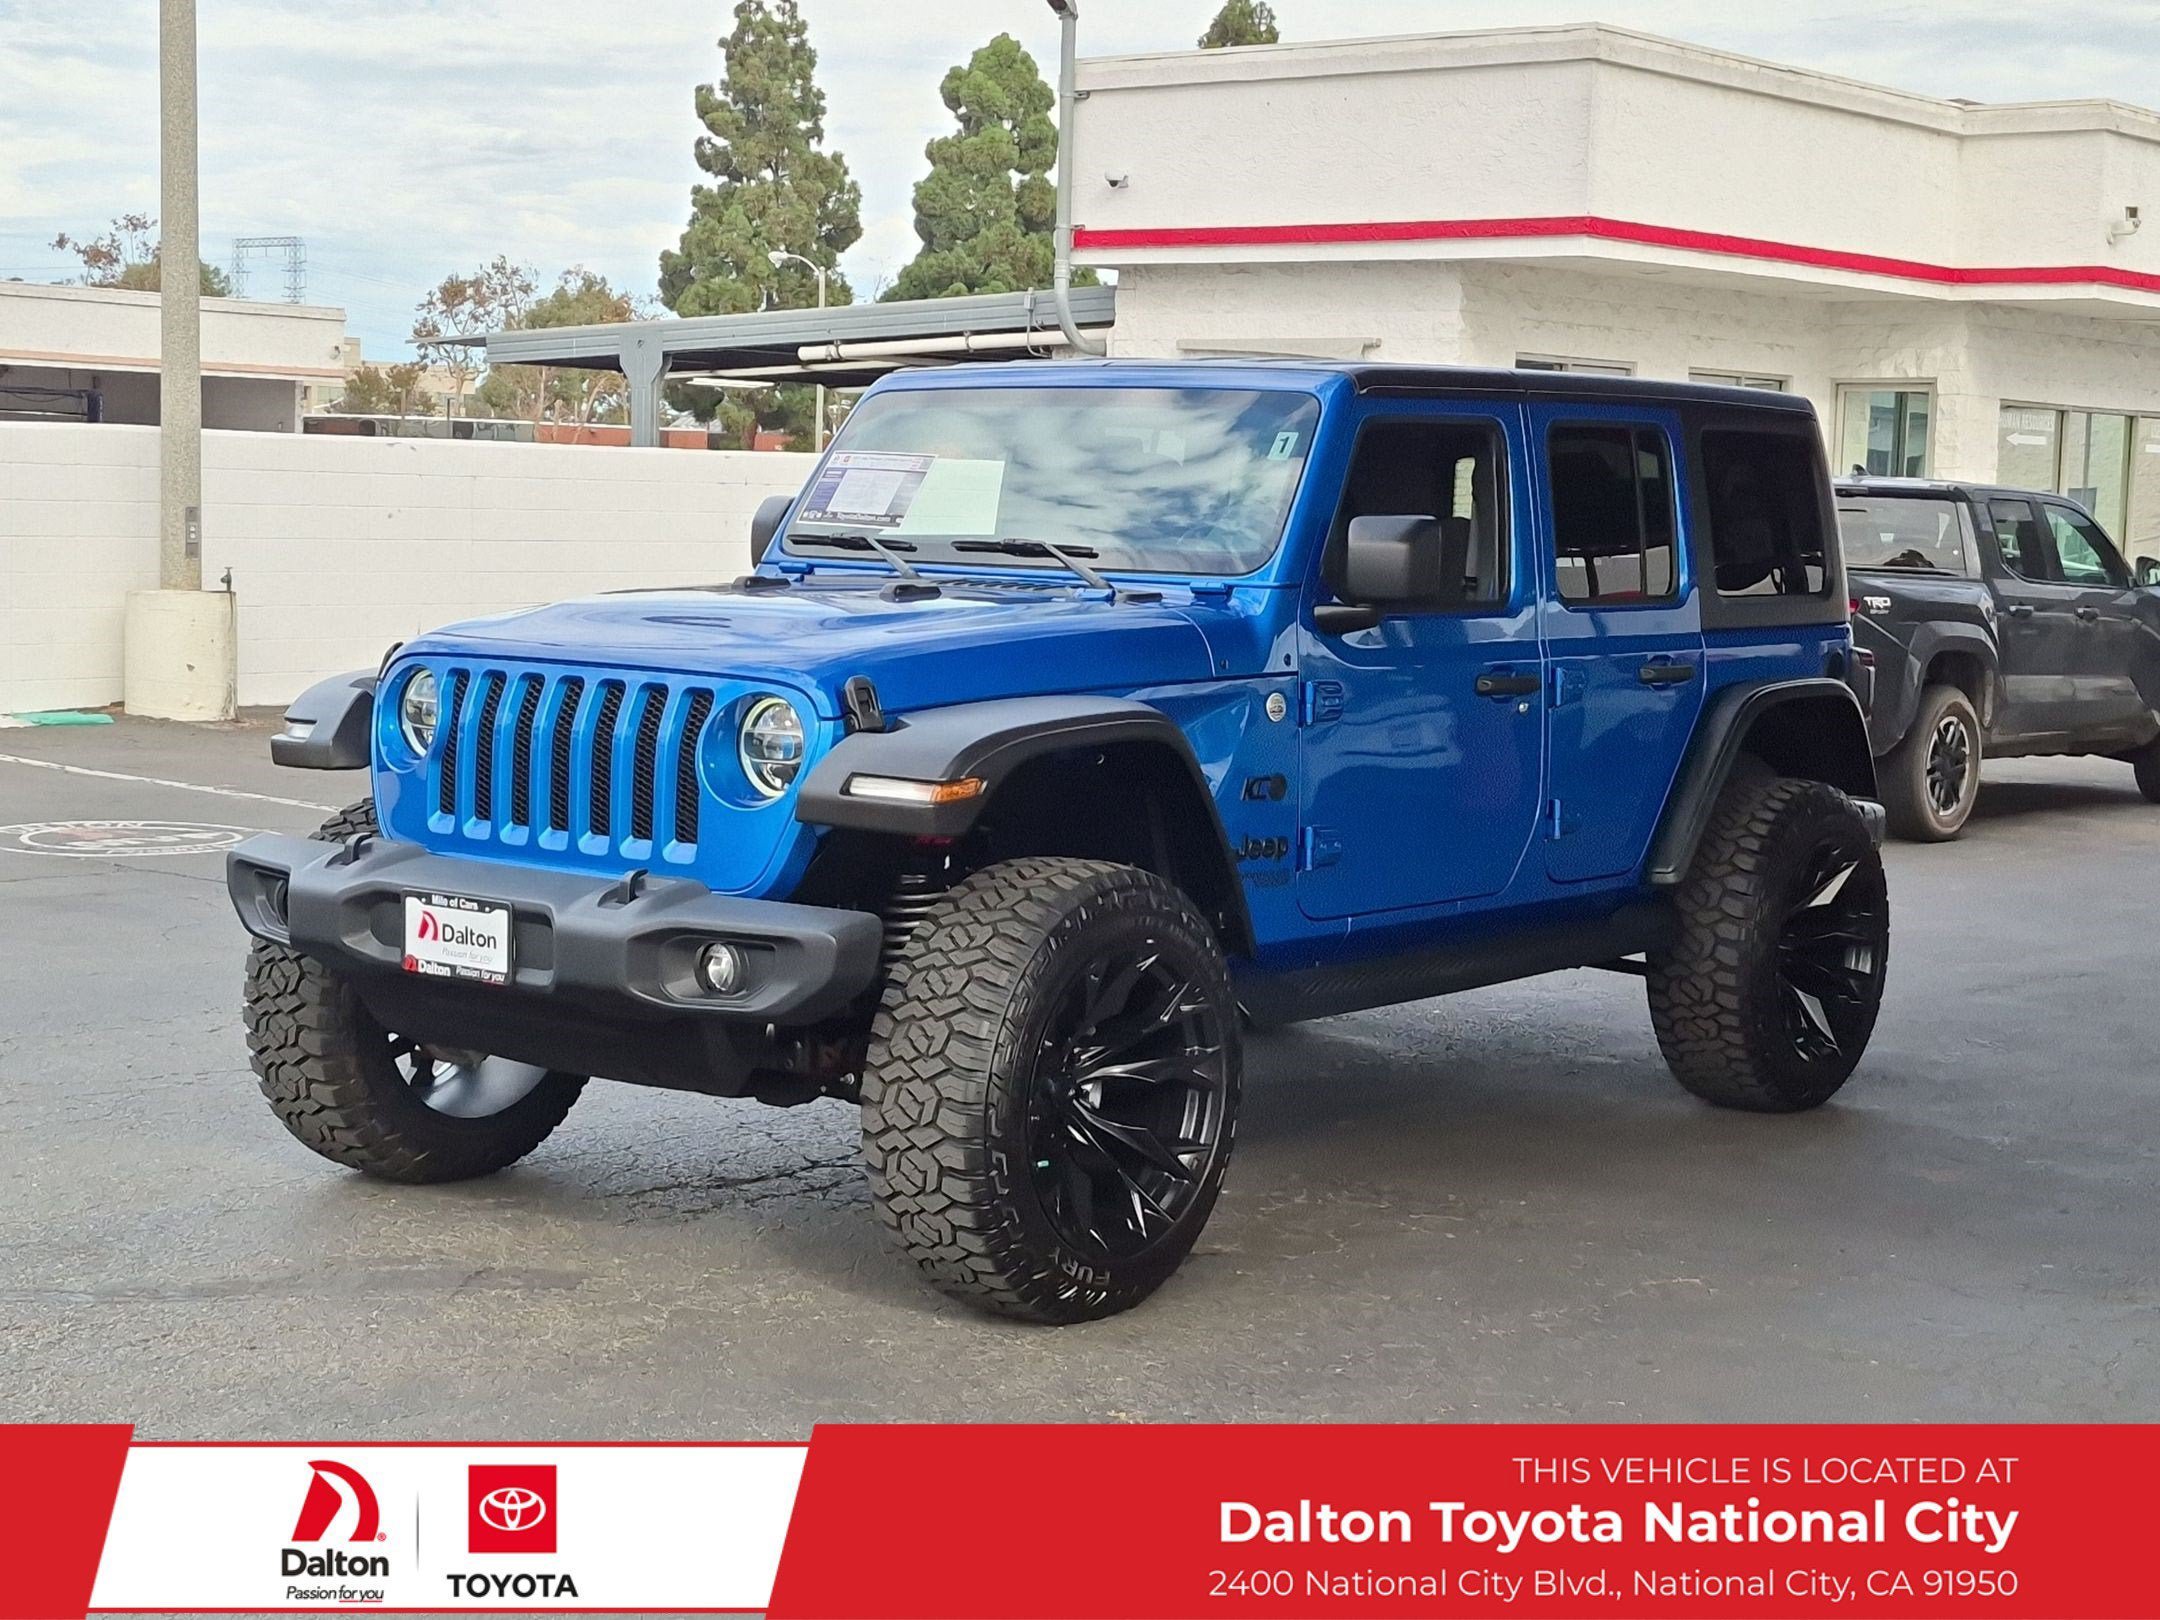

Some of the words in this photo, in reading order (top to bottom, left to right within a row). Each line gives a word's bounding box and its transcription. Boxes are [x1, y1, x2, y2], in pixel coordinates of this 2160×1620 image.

[1863, 596, 1892, 609] TRD
[1238, 834, 1288, 861] Jeep
[449, 897, 458, 908] of
[442, 923, 497, 950] Dalton
[417, 960, 451, 977] Dalton
